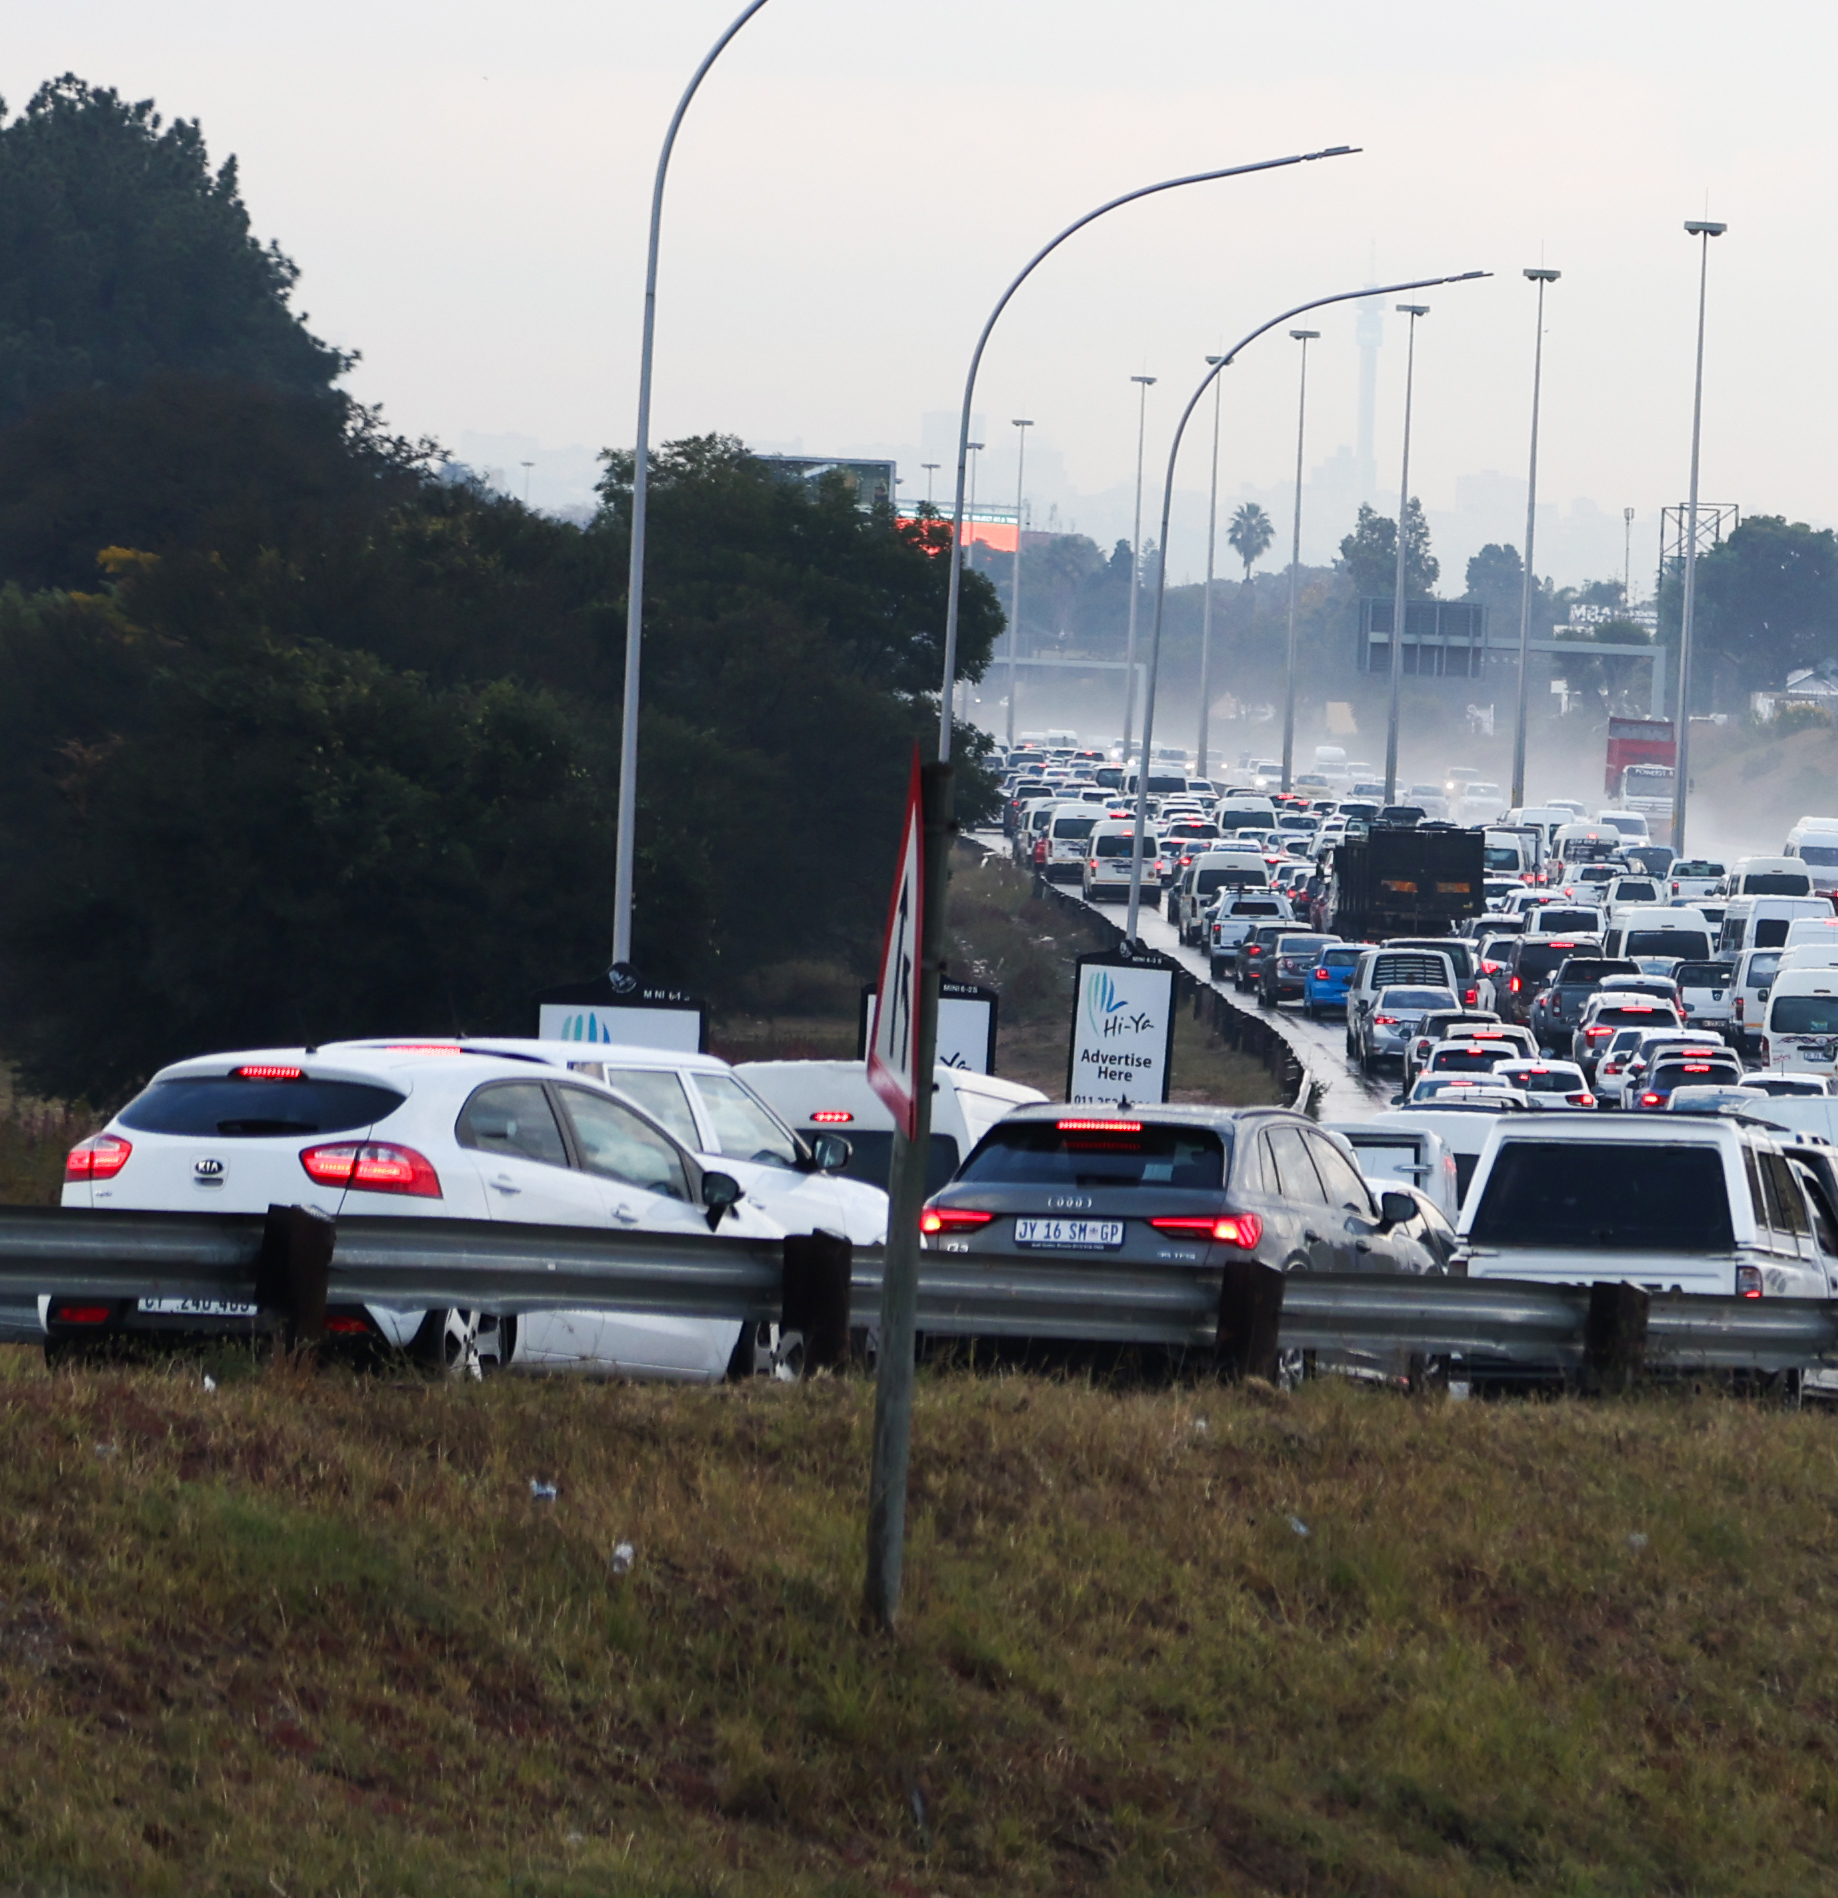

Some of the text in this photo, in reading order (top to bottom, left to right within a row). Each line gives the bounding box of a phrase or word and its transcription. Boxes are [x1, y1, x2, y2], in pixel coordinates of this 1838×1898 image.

[1103, 1012, 1155, 1038] Hi-Ya
[1081, 1048, 1152, 1068] Advertise
[1097, 1066, 1133, 1082] Here
[198, 1161, 219, 1172] KIA
[1019, 1218, 1119, 1241] JY 16 SM GP
